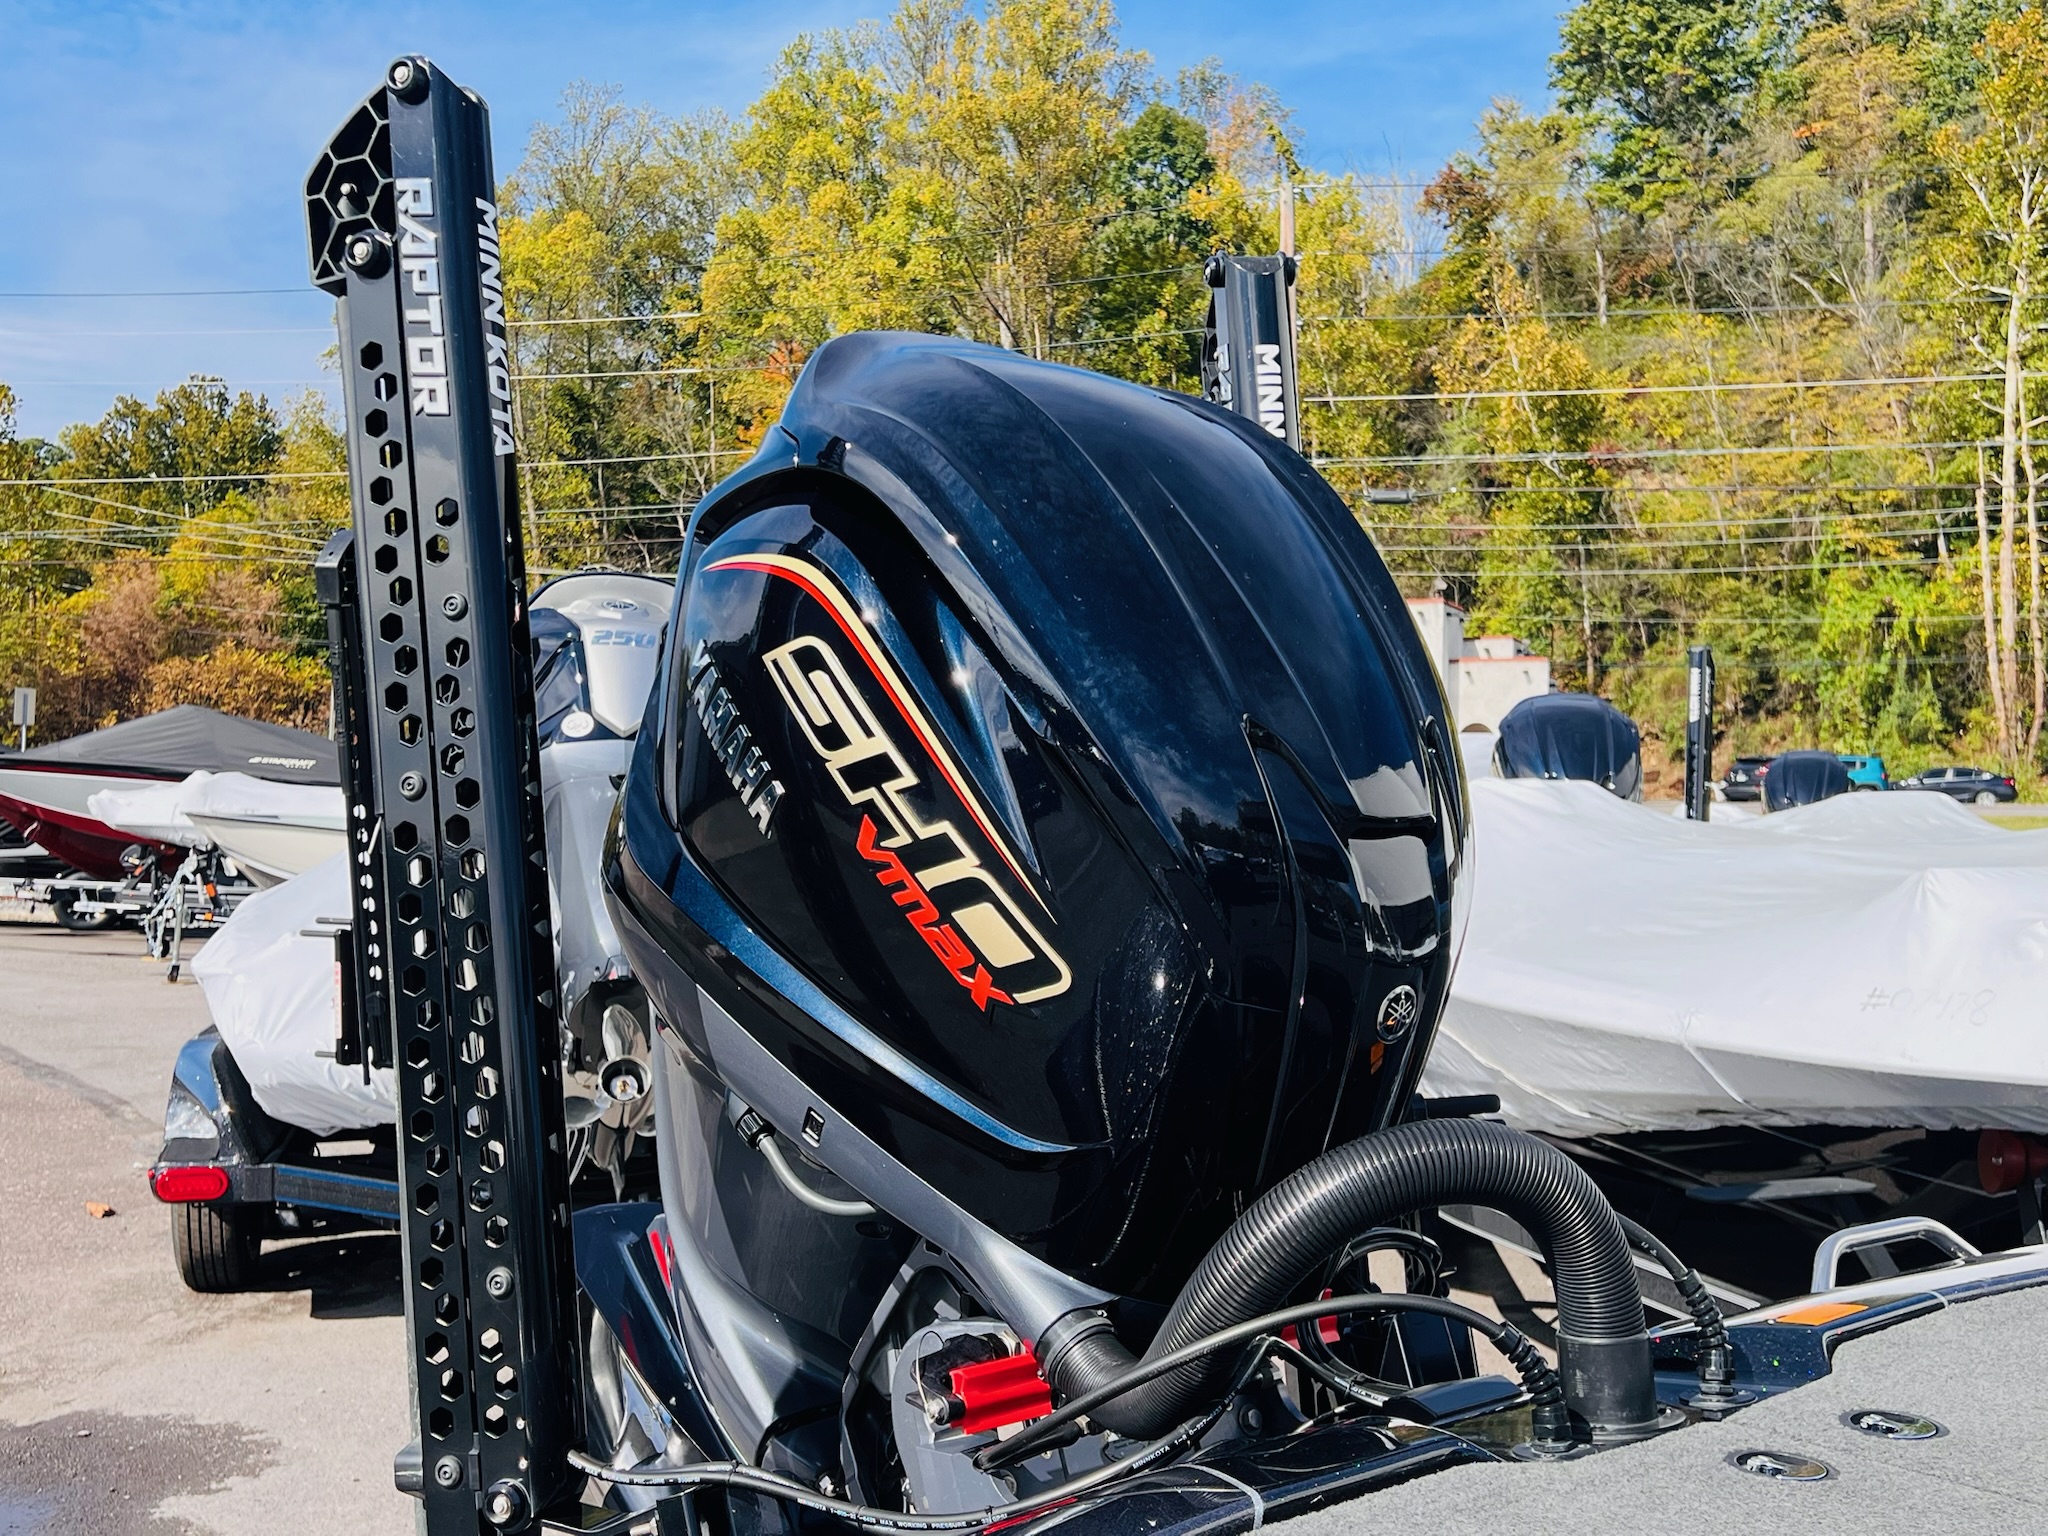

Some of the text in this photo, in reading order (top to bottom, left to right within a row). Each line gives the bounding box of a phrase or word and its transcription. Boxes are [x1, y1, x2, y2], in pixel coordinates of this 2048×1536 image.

[395, 177, 450, 416] RAPTOR
[475, 197, 515, 457] MINN KOTA
[1255, 344, 1286, 438] MINN
[591, 629, 656, 649] 250
[686, 639, 785, 839] YAMAHA
[1131, 1445, 1170, 1470] MINNKOTA
[880, 1518, 894, 1527] MAX
[897, 1520, 928, 1530] WORKING
[931, 1520, 968, 1530] PRESSURE
